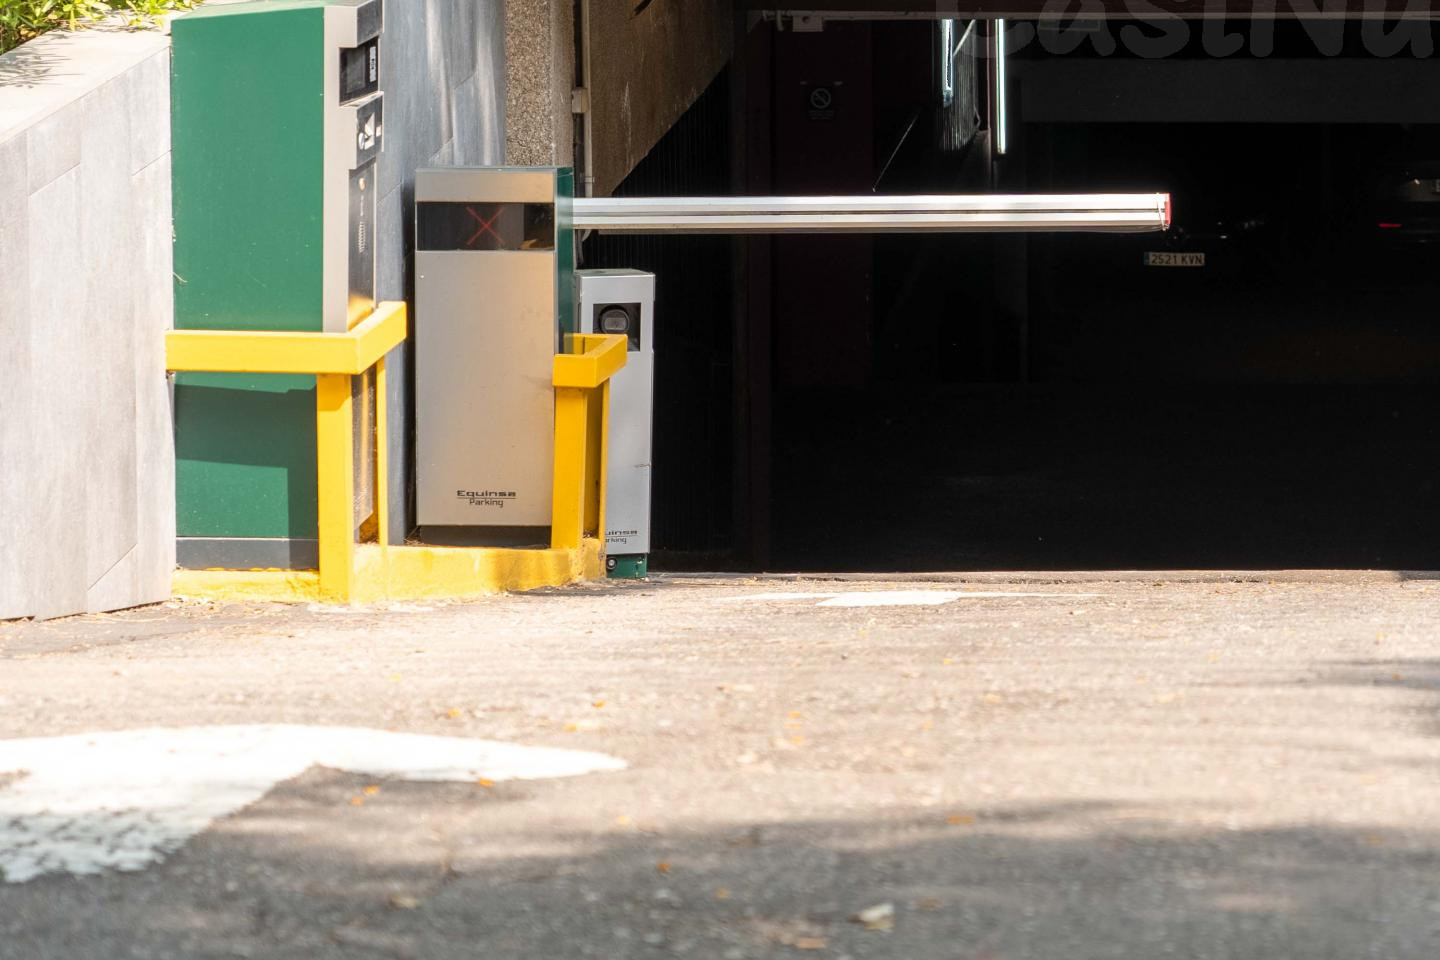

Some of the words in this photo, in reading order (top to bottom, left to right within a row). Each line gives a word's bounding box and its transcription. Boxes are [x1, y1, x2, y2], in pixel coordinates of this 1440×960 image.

[1151, 254, 1178, 265] 2521
[1181, 254, 1203, 265] KVN
[469, 498, 504, 508] Parking
